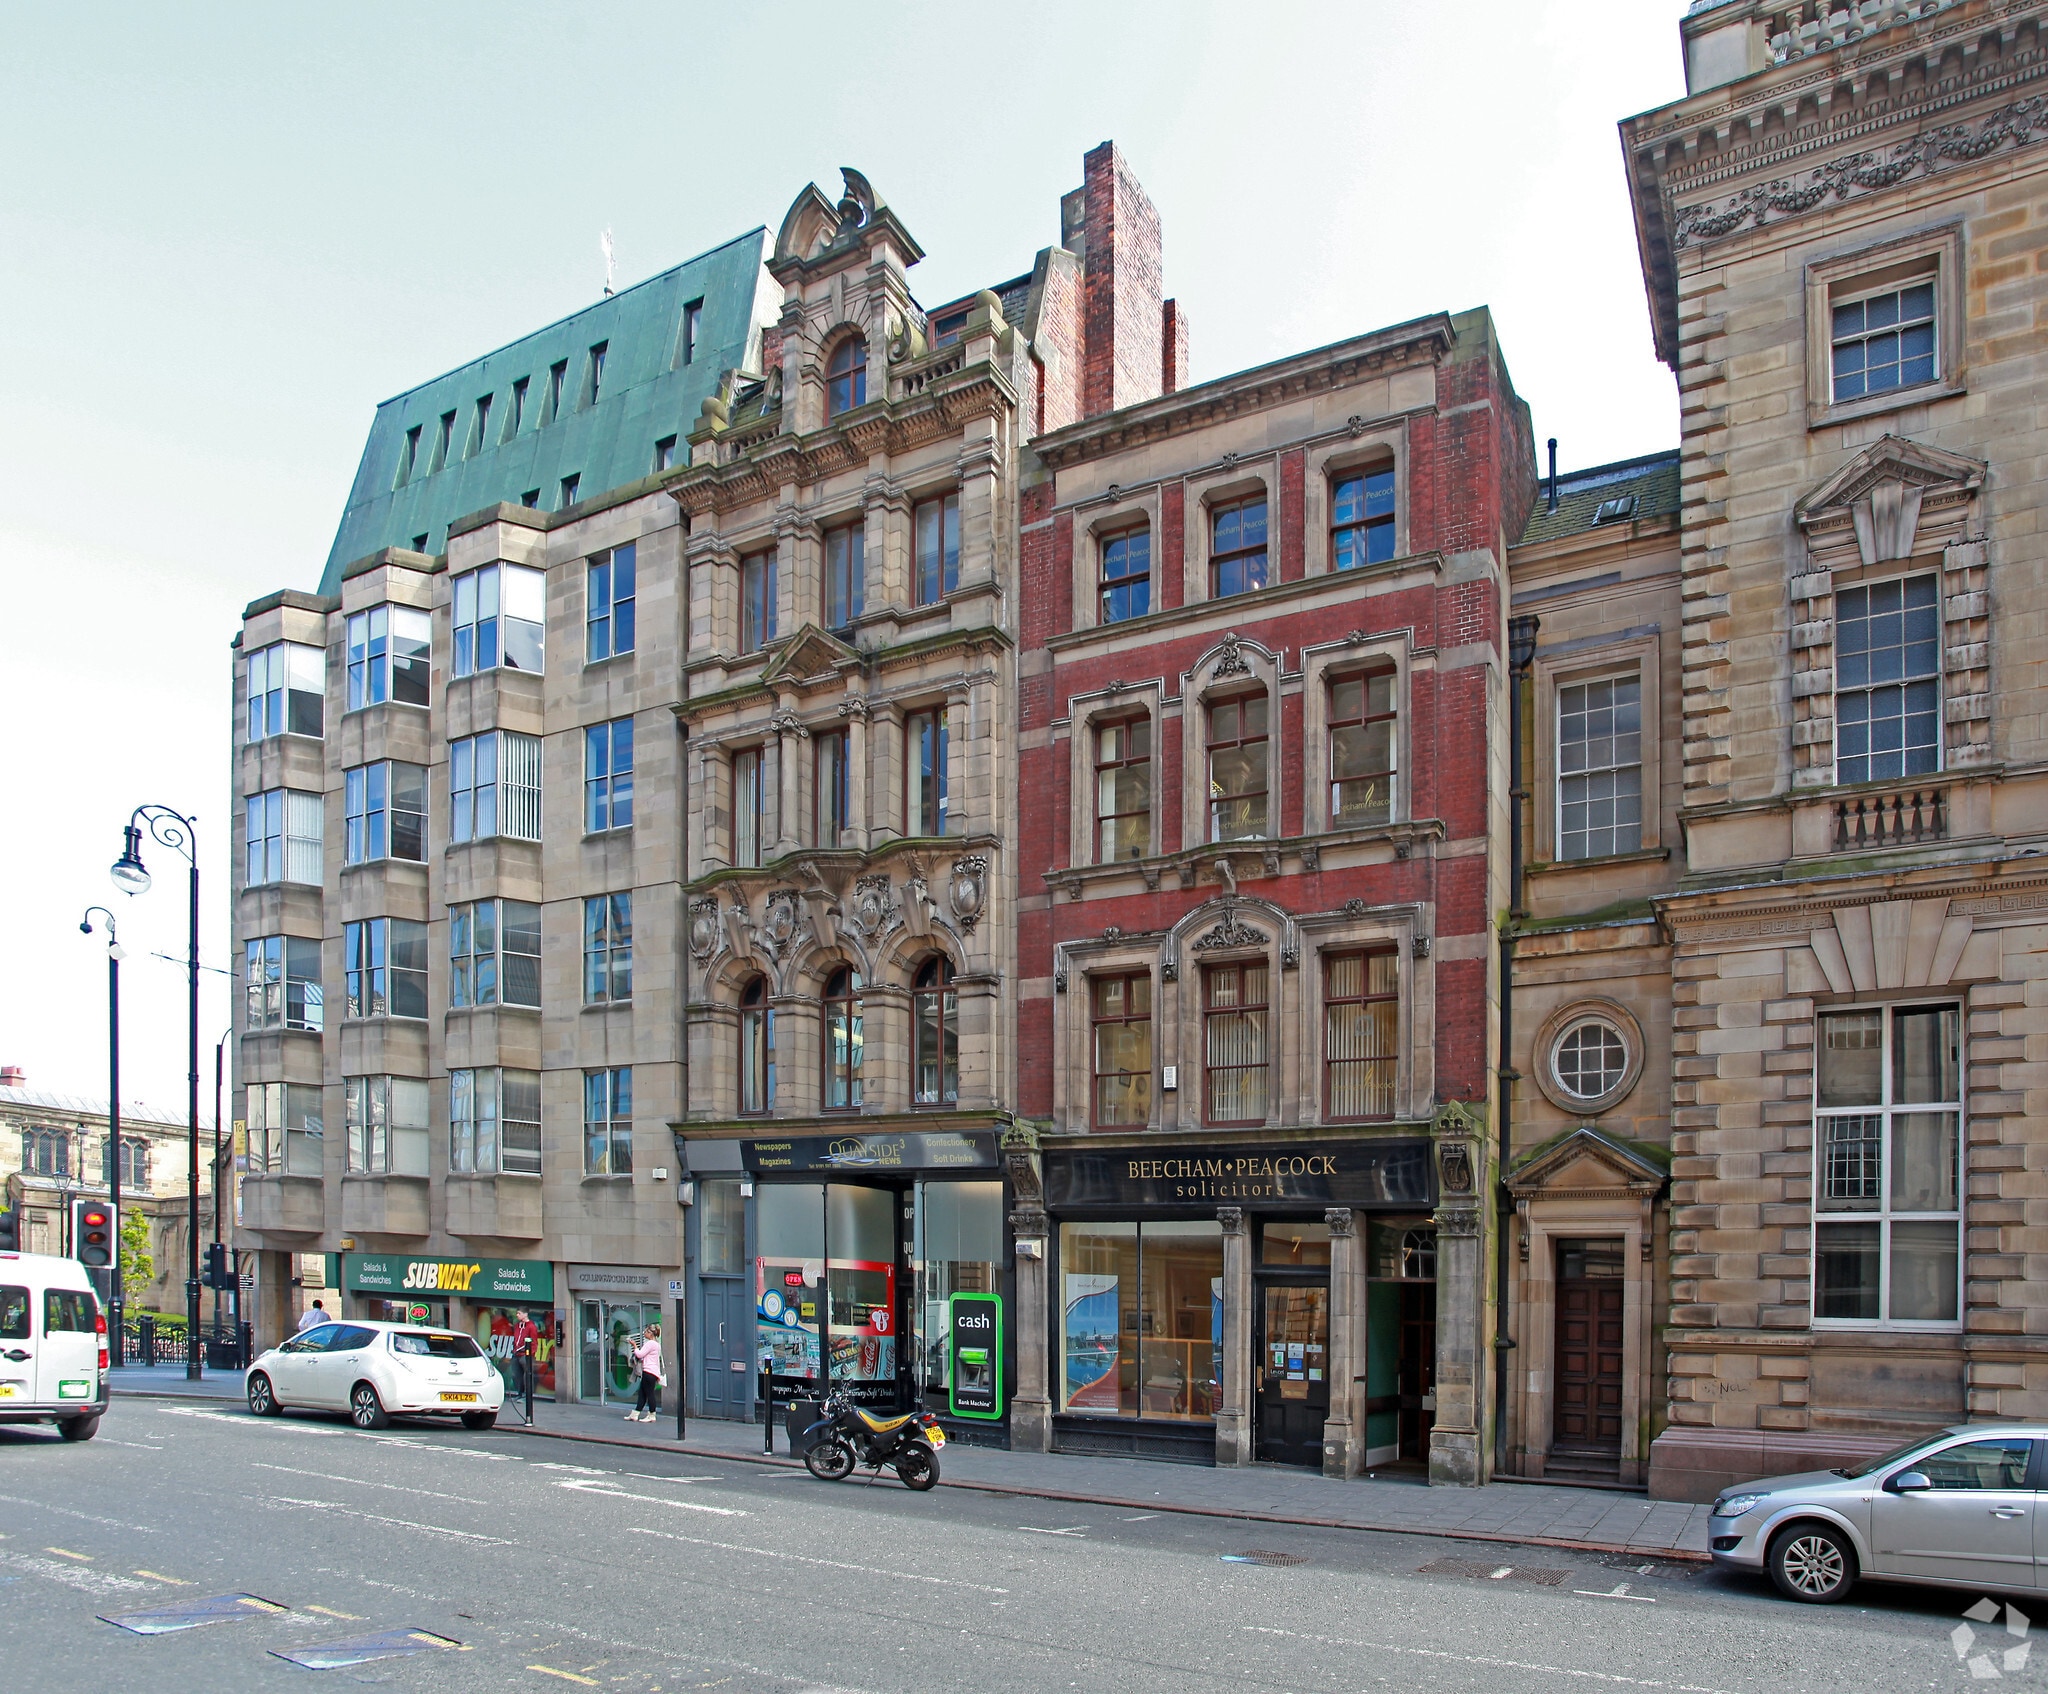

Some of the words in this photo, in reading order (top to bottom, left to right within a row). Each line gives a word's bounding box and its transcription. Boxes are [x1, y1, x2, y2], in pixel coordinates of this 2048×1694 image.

[1366, 486, 1394, 499] Peacock
[1214, 526, 1240, 537] eecham
[1105, 553, 1127, 565] eecham
[1368, 799, 1392, 808] Peaco
[1131, 832, 1150, 843] Peaco
[754, 1142, 792, 1152] Newspapers
[926, 1138, 976, 1148] Confectionery
[759, 1157, 792, 1168] Magazines
[879, 1157, 902, 1165] NEWS
[933, 1154, 948, 1163] Soft
[949, 1154, 973, 1163] Drinks
[1128, 1159, 1223, 1179] BEECHAM
[1235, 1155, 1337, 1177] PEACOCK
[1176, 1180, 1285, 1197] solicitors
[904, 1207, 914, 1219] OP
[903, 1241, 914, 1254] QU
[1291, 1236, 1302, 1253] 7
[1402, 1247, 1413, 1261] 7
[363, 1262, 382, 1272] Salads
[382, 1263, 387, 1272] &
[498, 1267, 520, 1279] Salads
[520, 1268, 526, 1279] &
[359, 1274, 392, 1285] Sandwiches
[402, 1262, 481, 1291] SUBWAY
[579, 1273, 626, 1284] COLLINGWOOD
[626, 1275, 649, 1285] HOUSE
[493, 1280, 532, 1292] Sandwiches
[958, 1313, 990, 1329] cash
[958, 1398, 970, 1406] Bank
[970, 1399, 990, 1408] Machine
